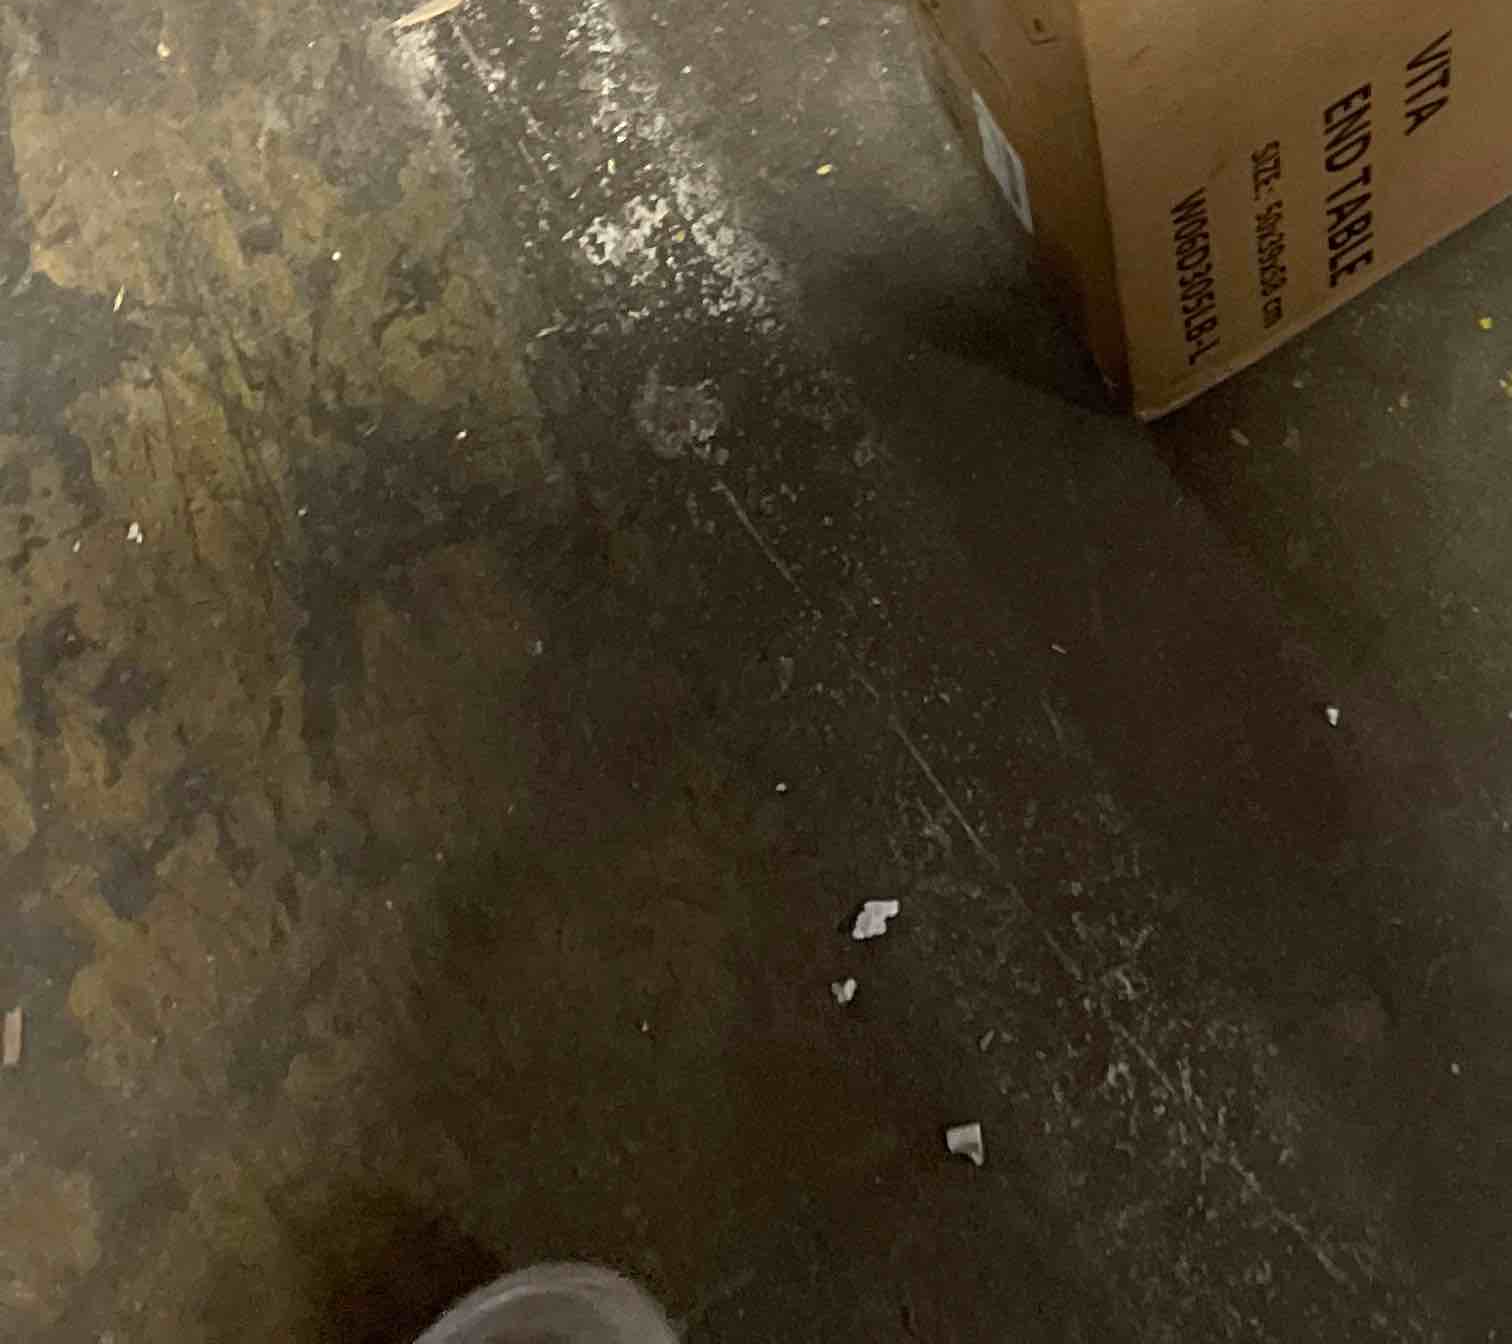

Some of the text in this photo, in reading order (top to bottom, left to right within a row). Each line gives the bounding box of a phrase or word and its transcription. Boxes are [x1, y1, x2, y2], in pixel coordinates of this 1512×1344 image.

[1404, 29, 1453, 137] VITA
[1323, 81, 1375, 289] END TABLE
